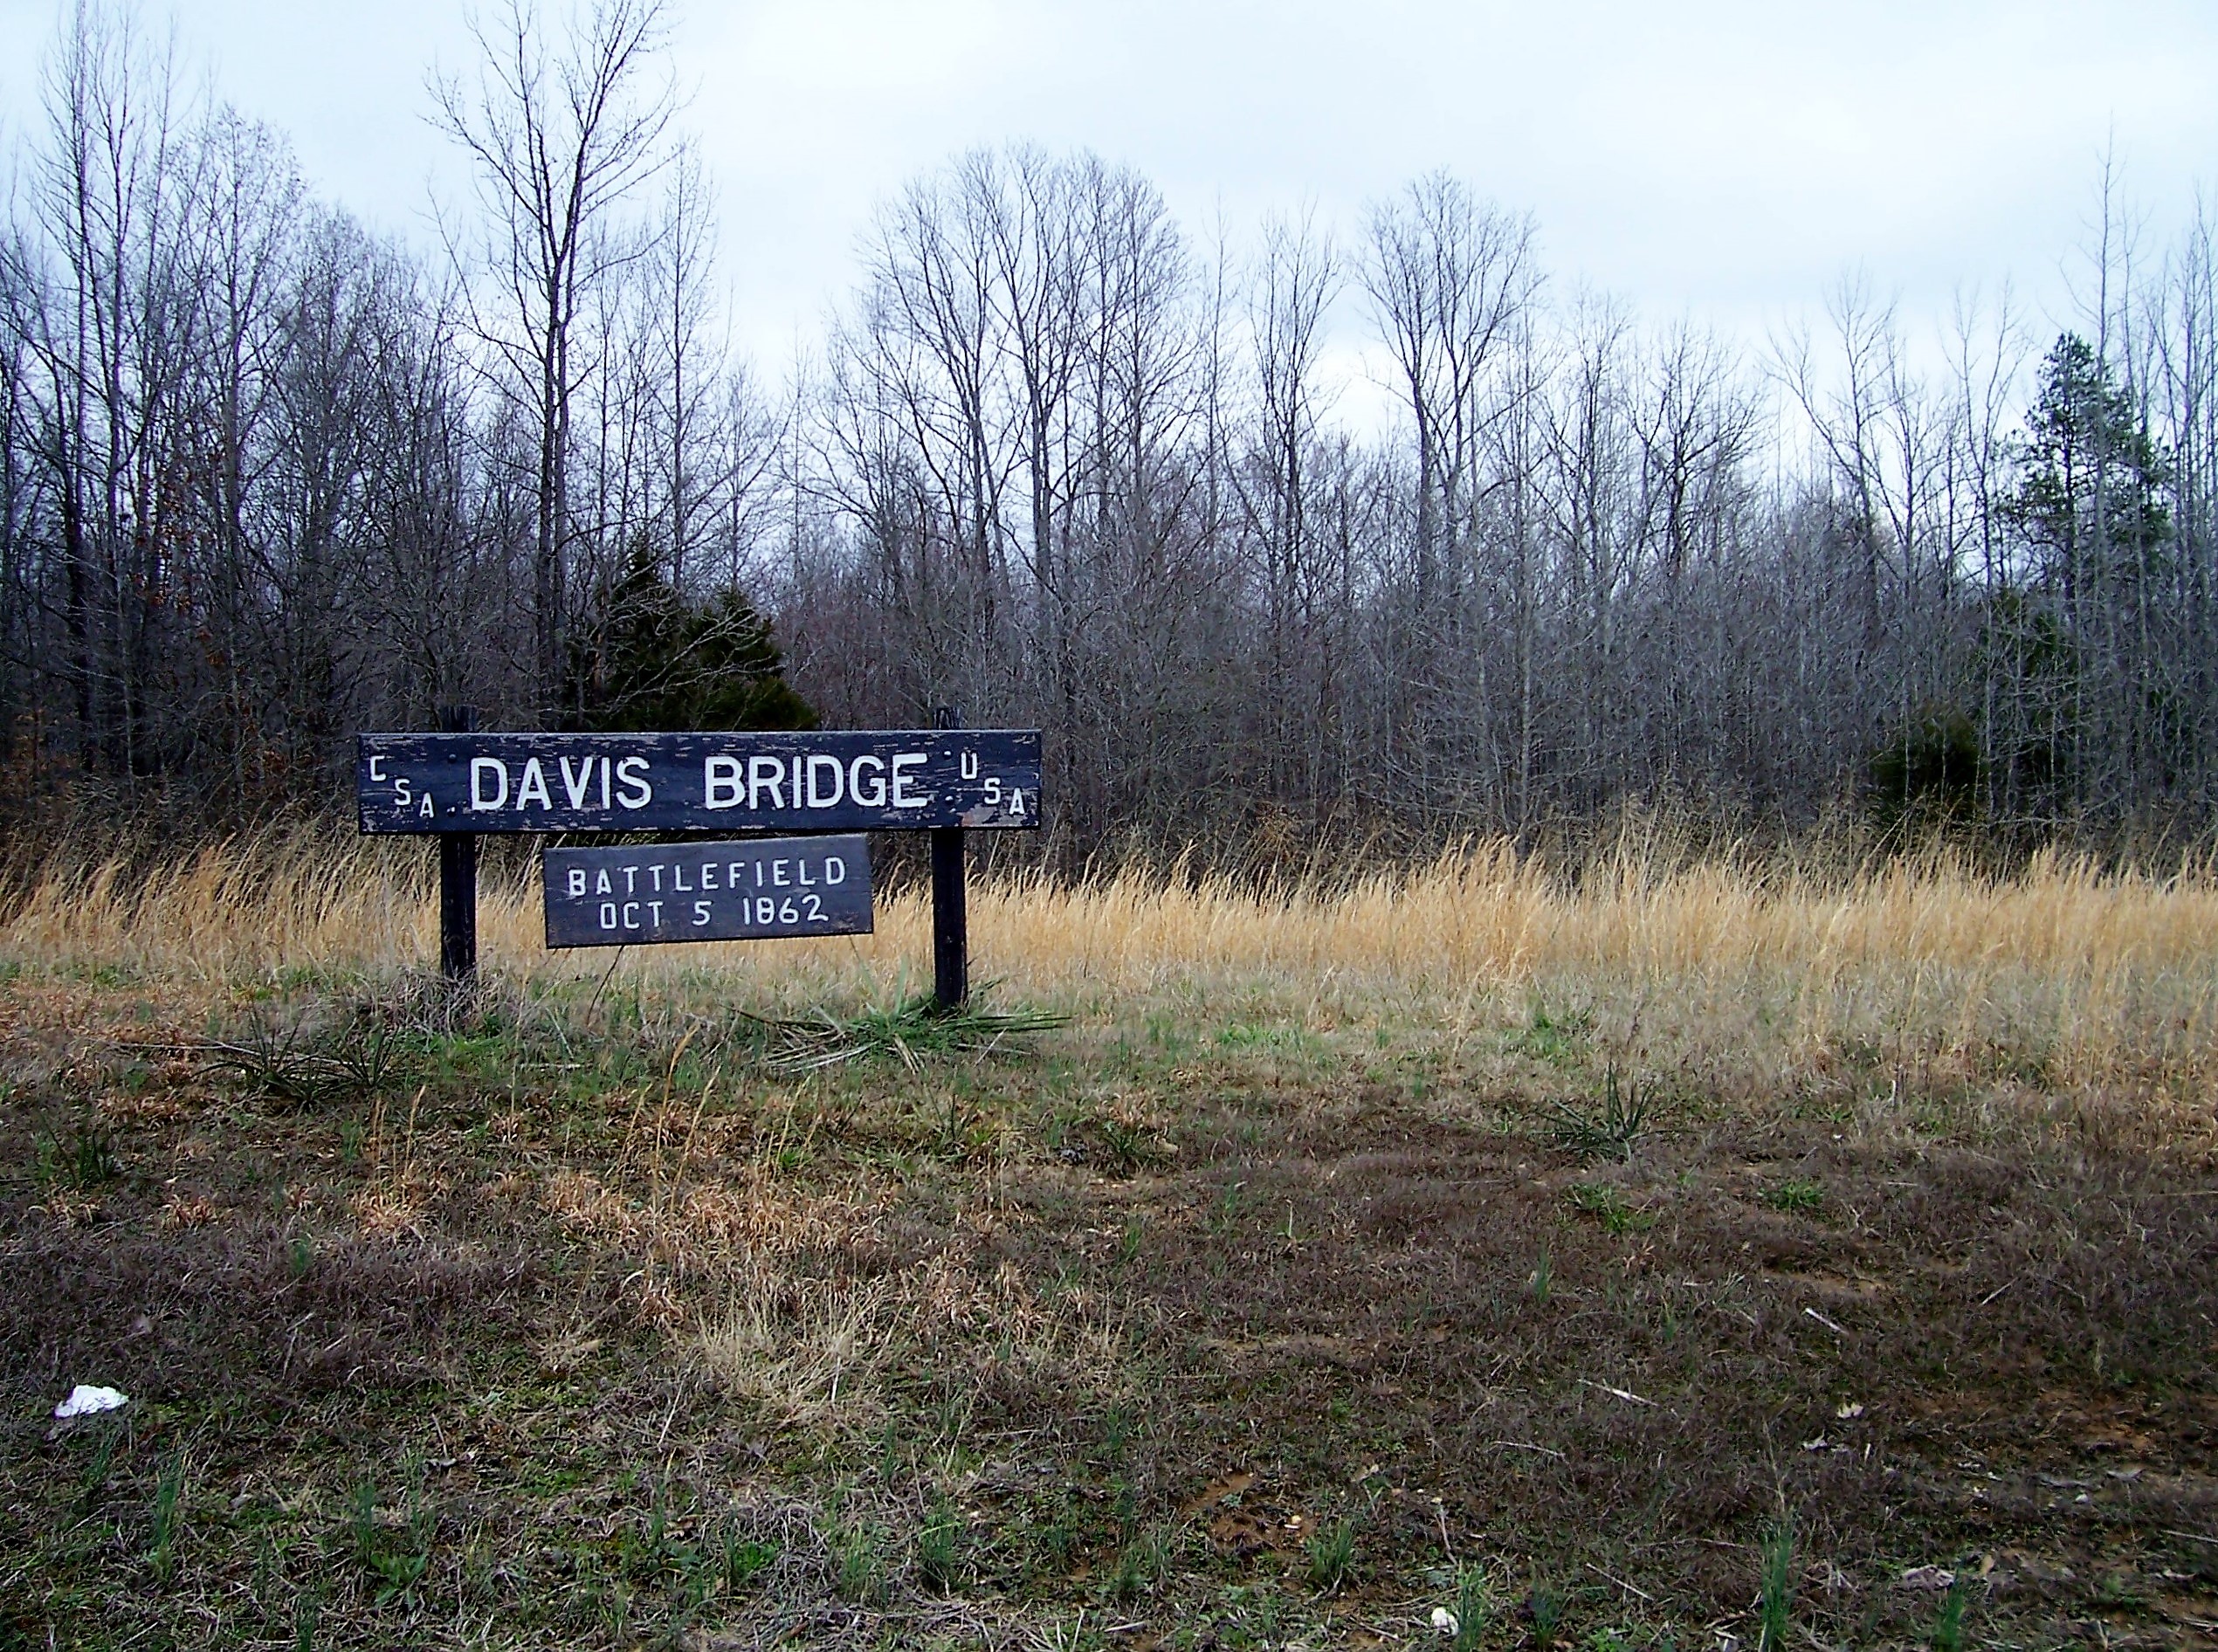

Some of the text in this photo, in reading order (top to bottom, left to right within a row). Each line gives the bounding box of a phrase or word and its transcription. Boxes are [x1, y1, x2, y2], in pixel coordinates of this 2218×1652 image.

[470, 752, 929, 812] DAVIS BRIDGE
[568, 856, 846, 898] BATTLEFIELD
[599, 893, 830, 930] OCT 5 1862
